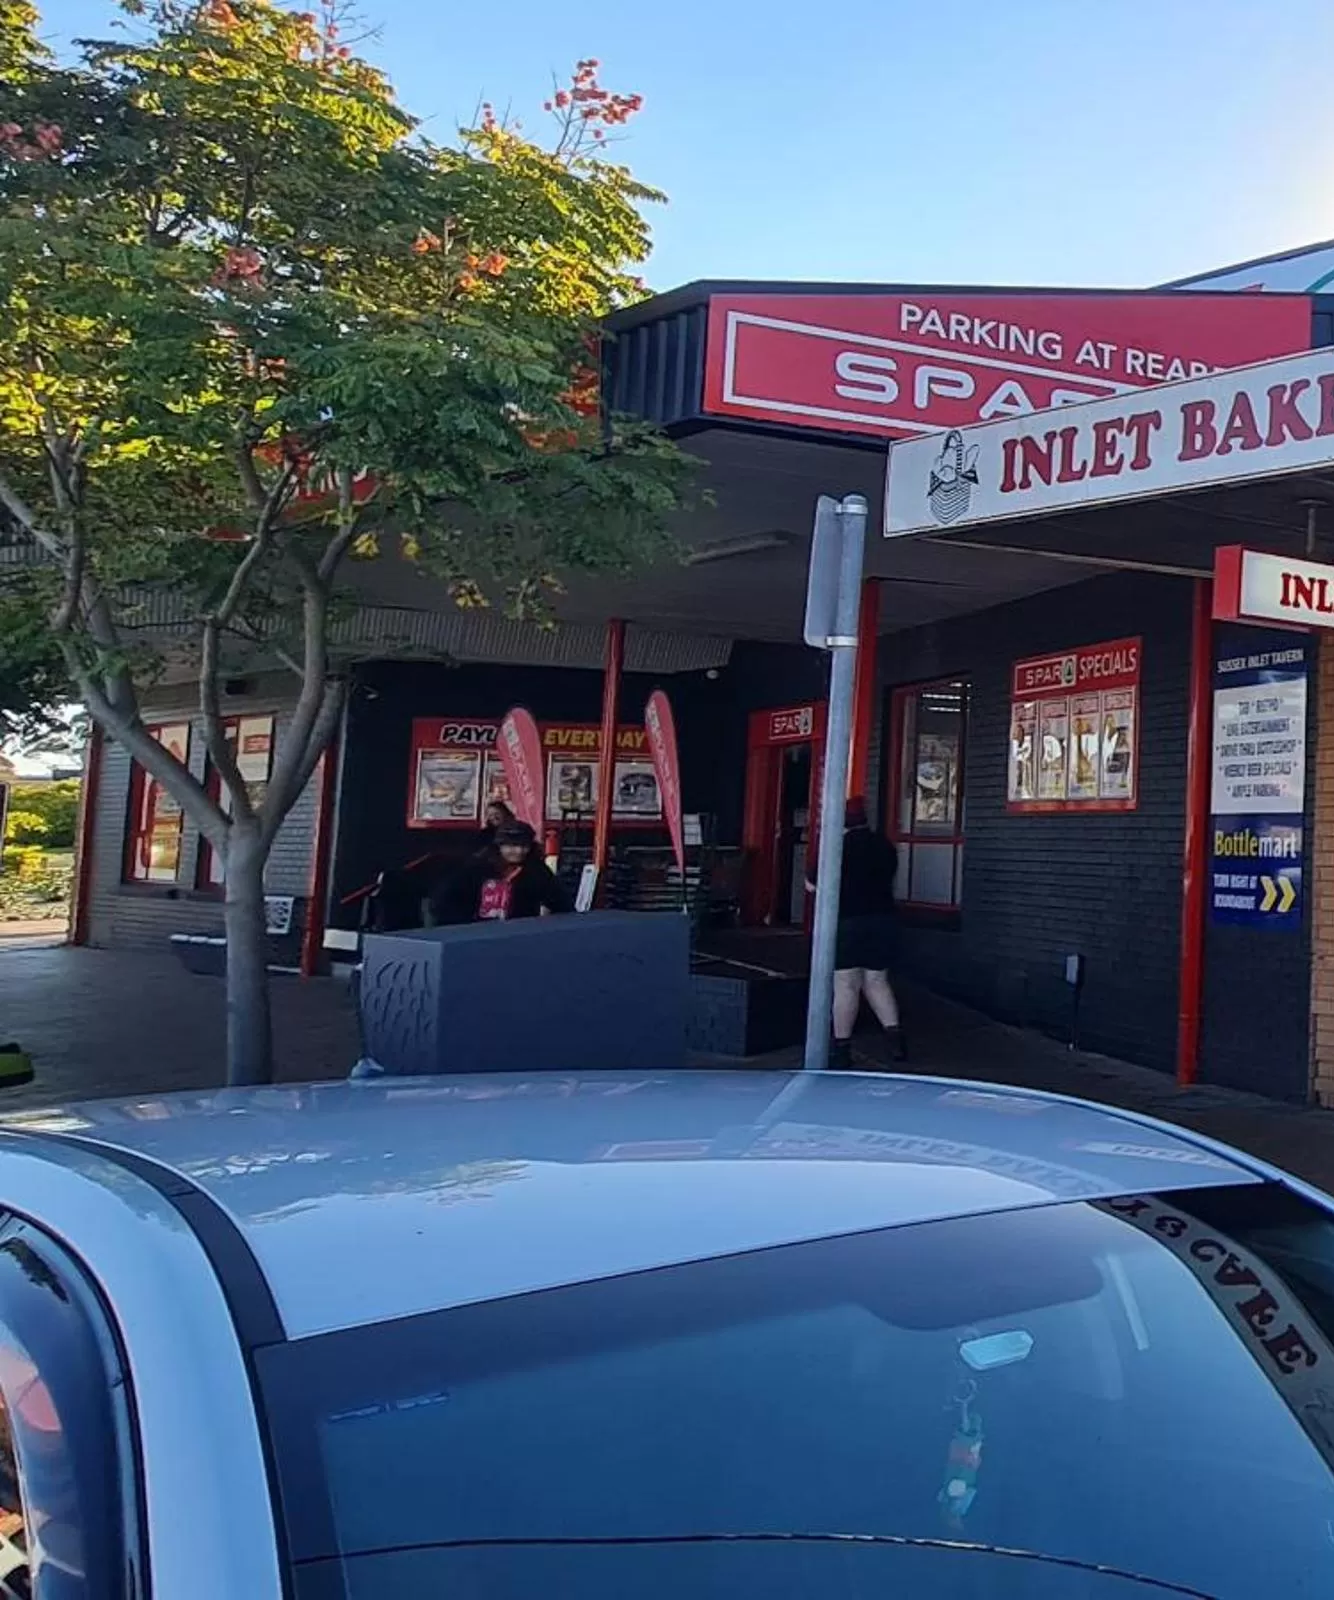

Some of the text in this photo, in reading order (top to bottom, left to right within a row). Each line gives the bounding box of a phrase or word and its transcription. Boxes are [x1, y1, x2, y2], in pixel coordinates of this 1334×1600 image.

[900, 303, 1064, 360] PARKING
[1075, 340, 1117, 370] AT
[1000, 410, 1162, 493] INLET
[1025, 648, 1136, 686] SPAR SPECIALS
[544, 728, 645, 748] EVERAY
[773, 714, 801, 734] SPAR
[1214, 828, 1297, 858] Bottlemart
